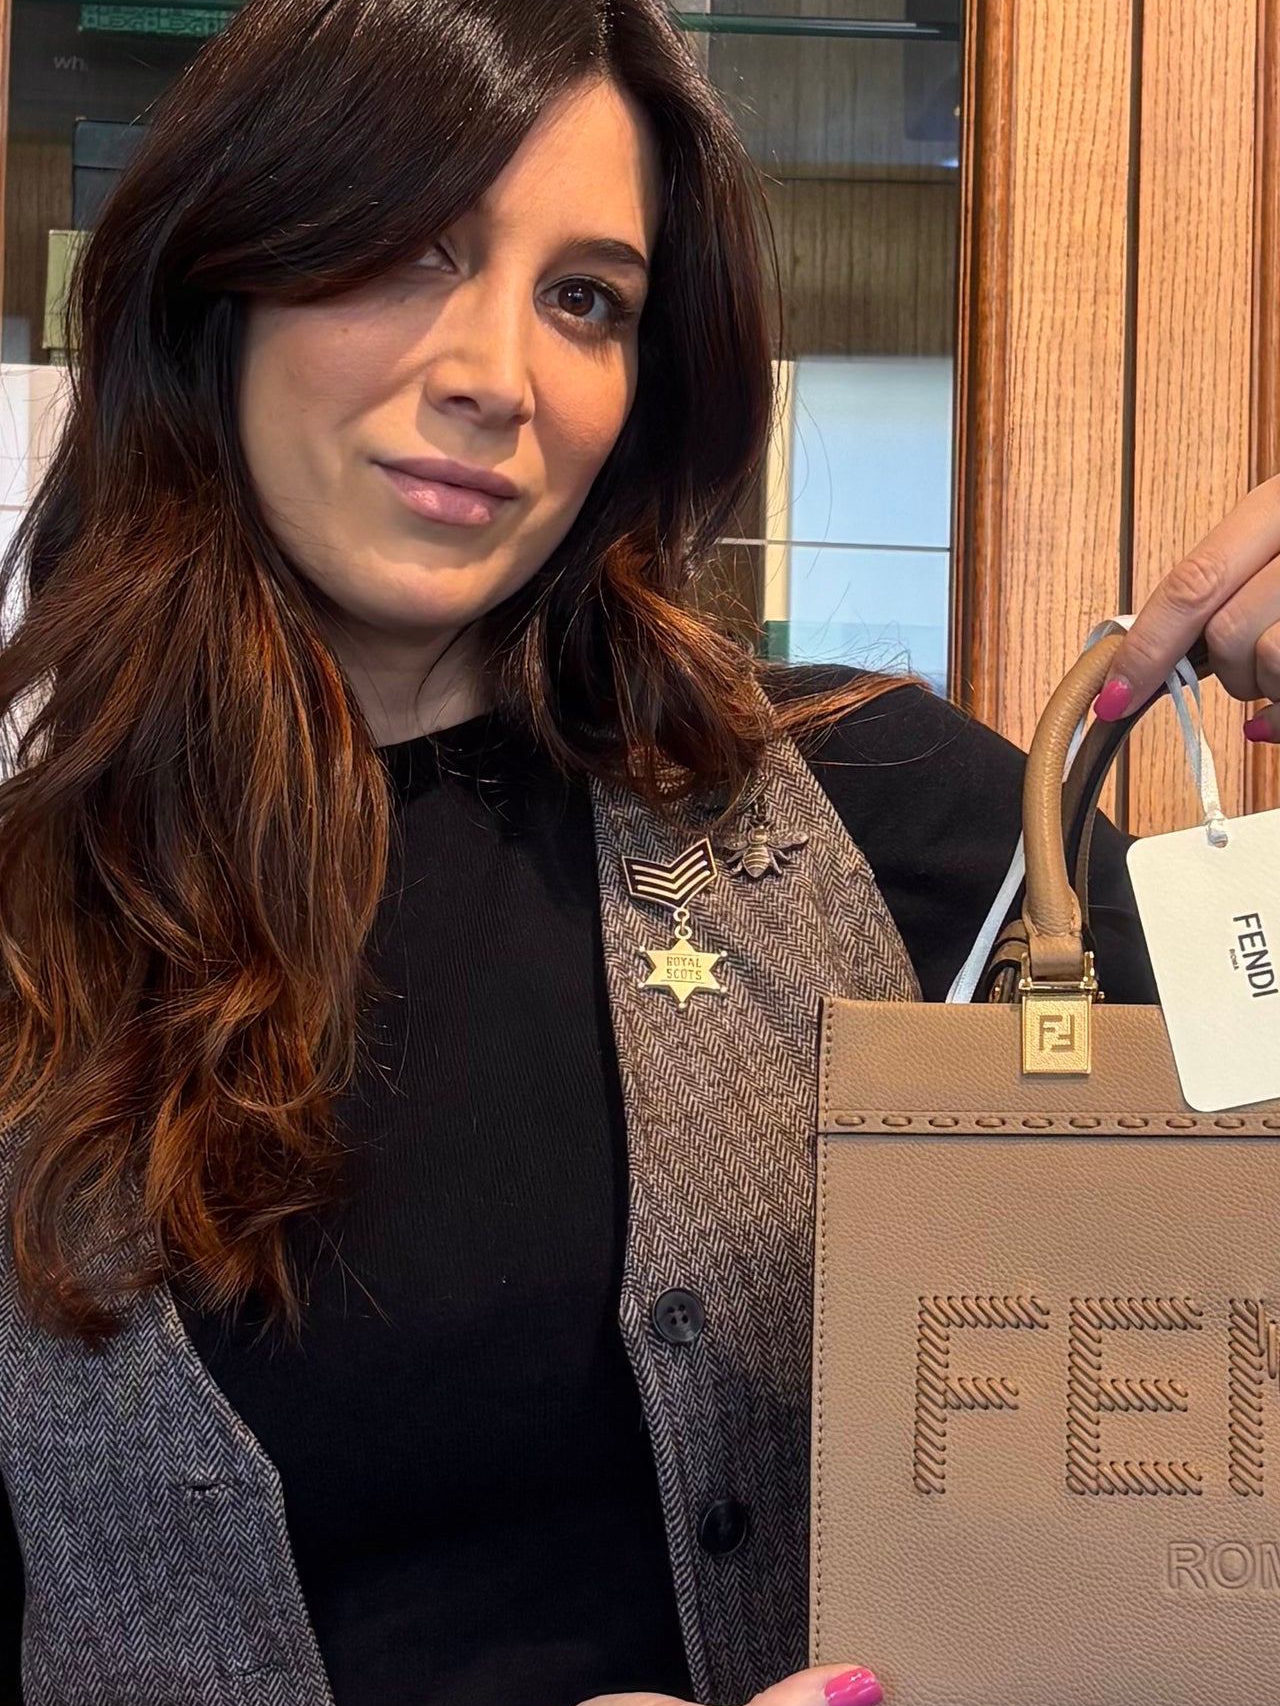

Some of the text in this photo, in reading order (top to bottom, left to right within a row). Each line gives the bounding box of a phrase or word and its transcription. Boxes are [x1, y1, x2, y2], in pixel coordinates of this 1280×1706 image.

[1232, 912, 1279, 998] FENDI
[666, 956, 702, 968] ROYAL
[666, 969, 703, 981] SCOTS
